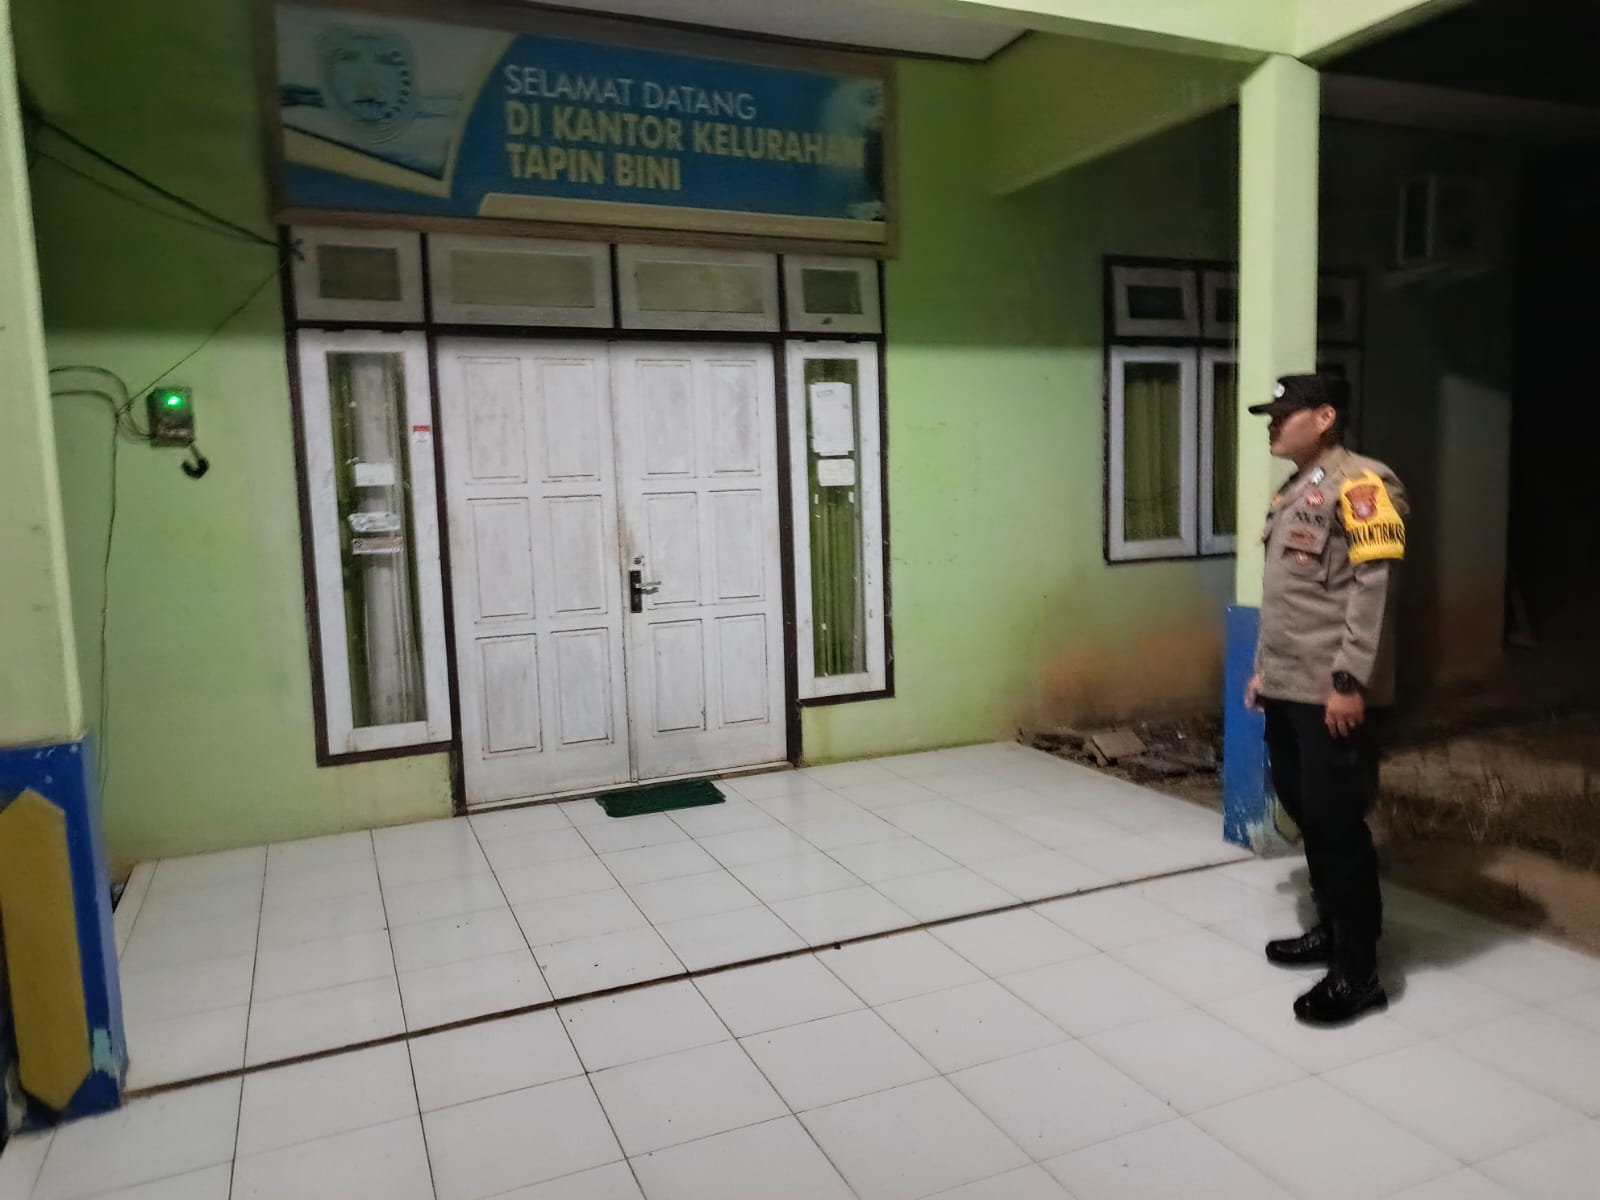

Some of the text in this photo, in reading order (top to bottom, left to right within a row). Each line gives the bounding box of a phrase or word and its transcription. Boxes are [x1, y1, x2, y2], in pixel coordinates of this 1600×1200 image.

[504, 65, 756, 120] SELAMAT DATANG
[506, 100, 540, 137] DI
[552, 106, 684, 151] KANTOR
[506, 143, 682, 191] TAPIN BINI
